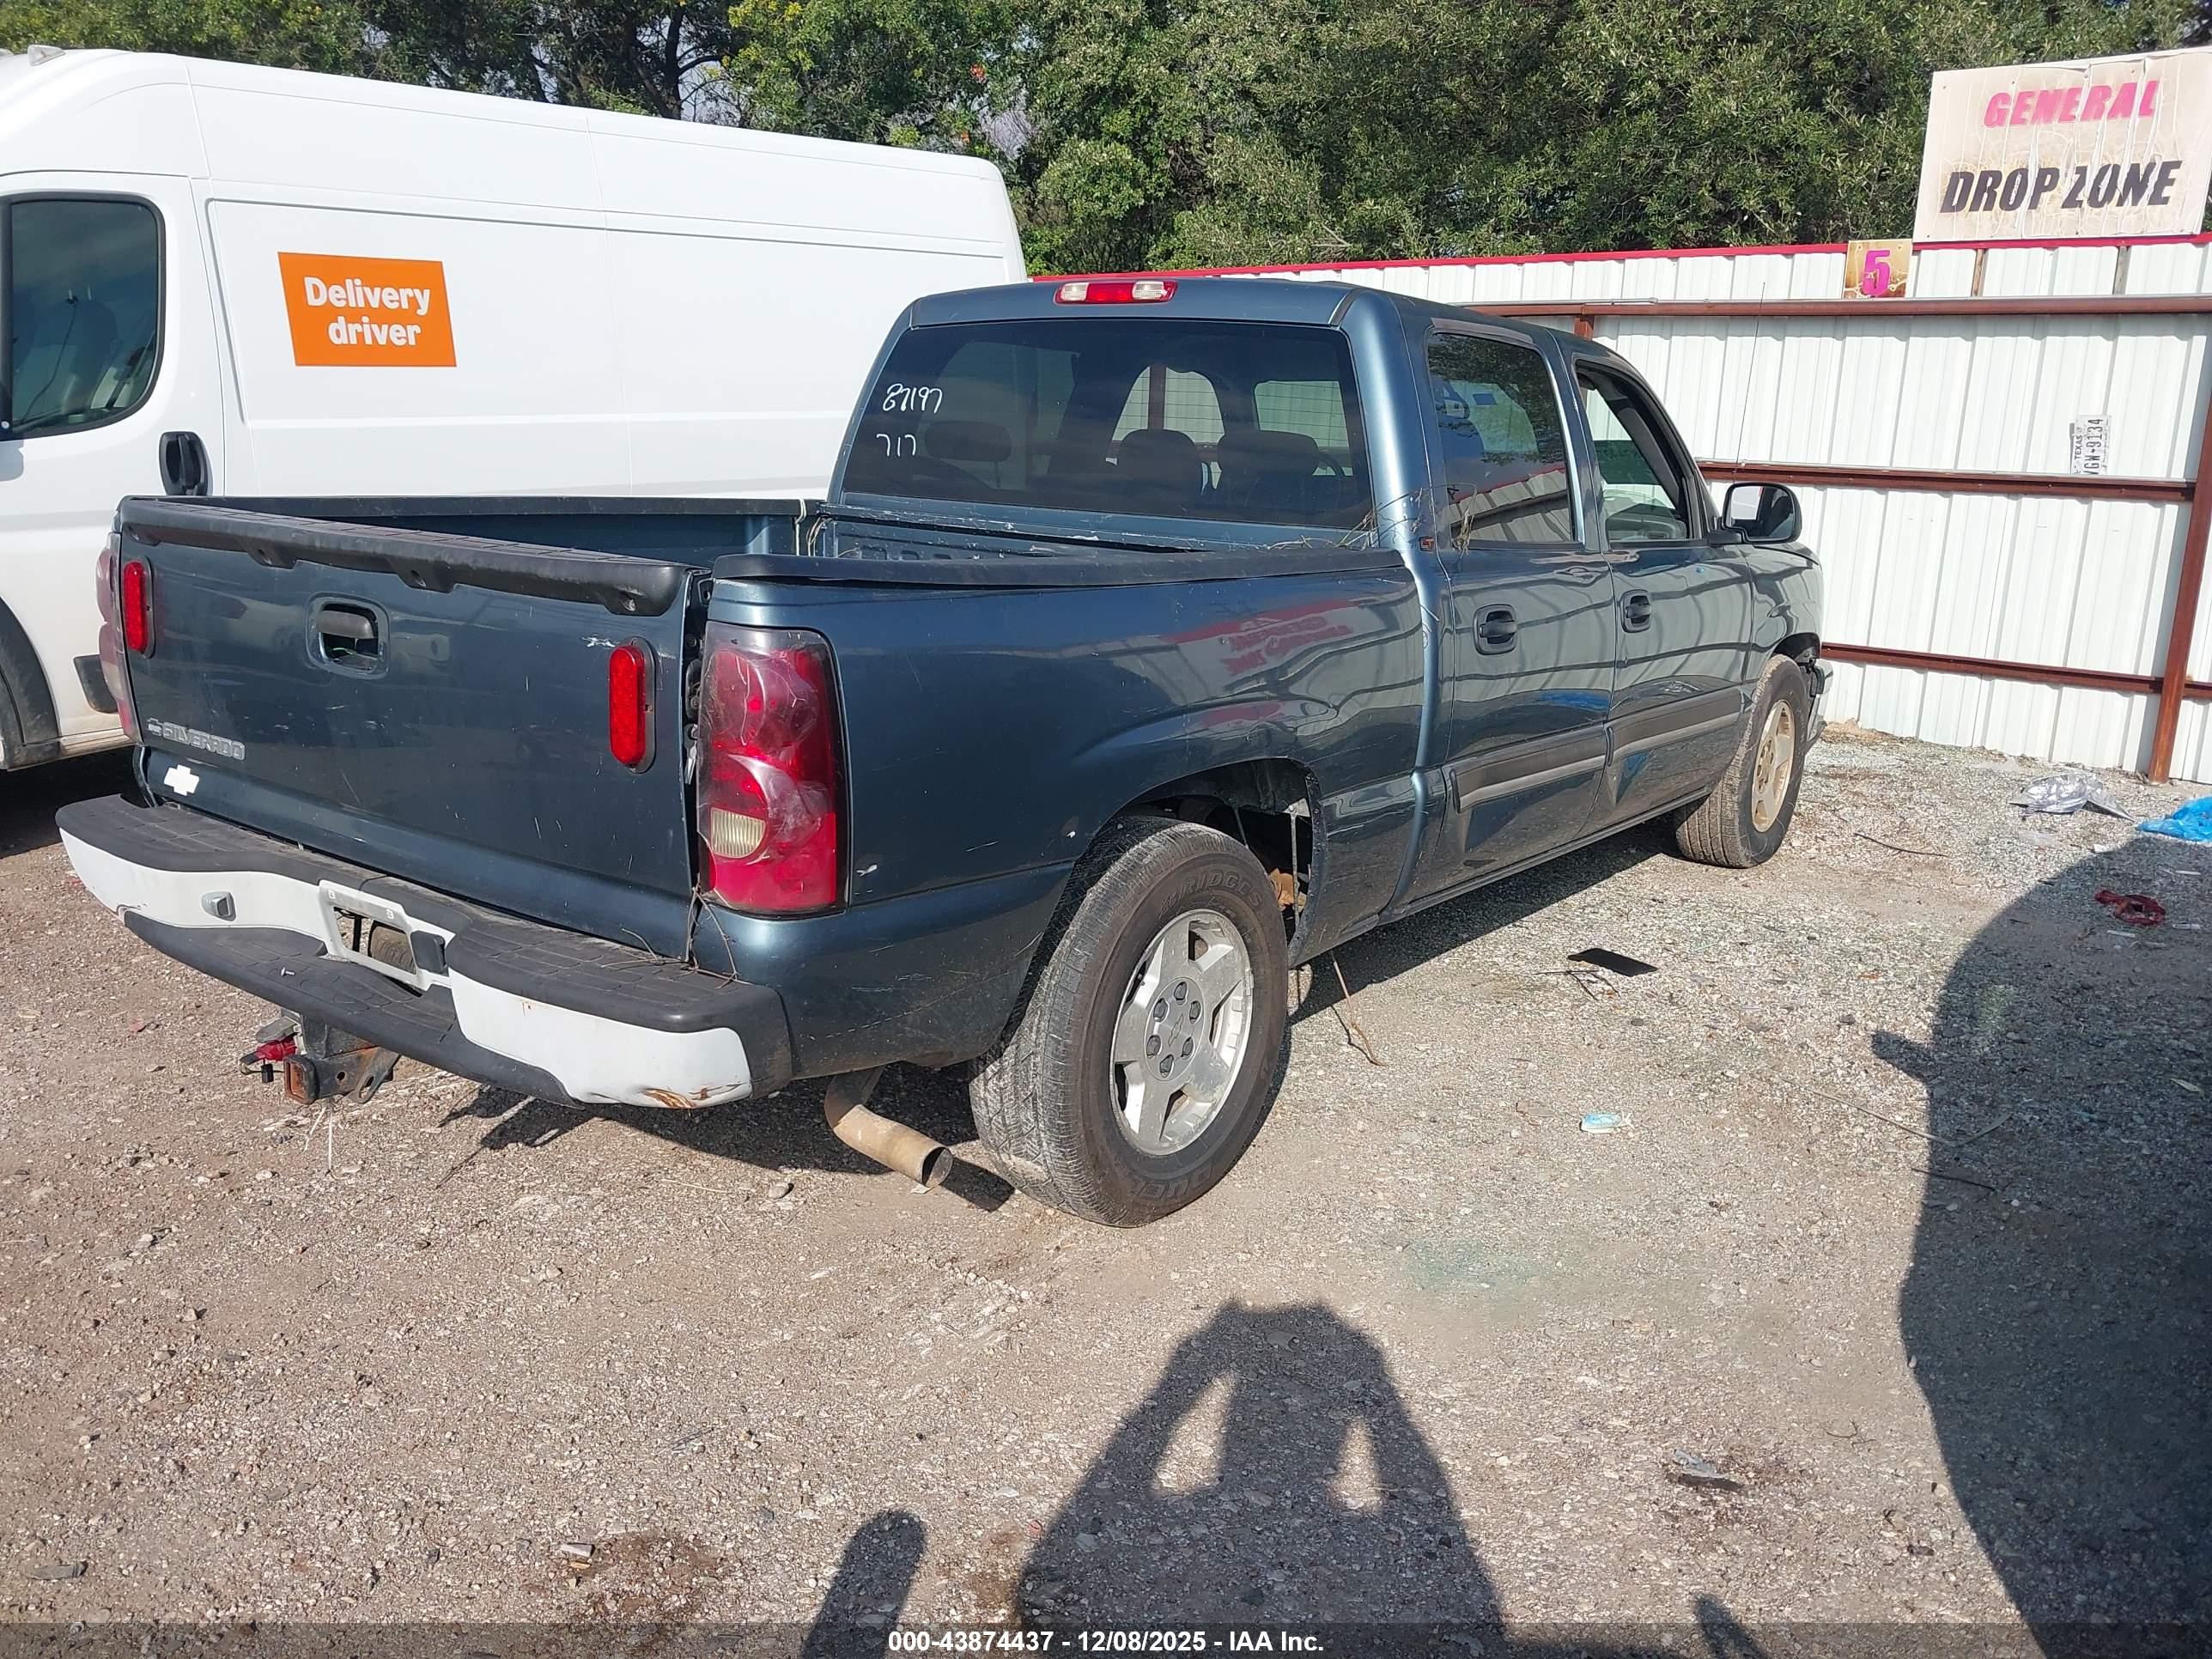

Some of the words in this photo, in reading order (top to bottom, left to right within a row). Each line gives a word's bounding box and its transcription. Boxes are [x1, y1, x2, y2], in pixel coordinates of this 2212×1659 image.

[1984, 80, 2160, 127] GENERAL
[1940, 167, 2060, 213] DROP
[2061, 161, 2183, 210] ZONE
[1863, 250, 1890, 295] 5
[303, 276, 430, 315] Delivery
[328, 316, 422, 346] driver
[882, 383, 942, 414] 87197
[876, 434, 916, 457] 717
[2074, 434, 2083, 460] TEXAS
[162, 721, 246, 761] SILVERADO
